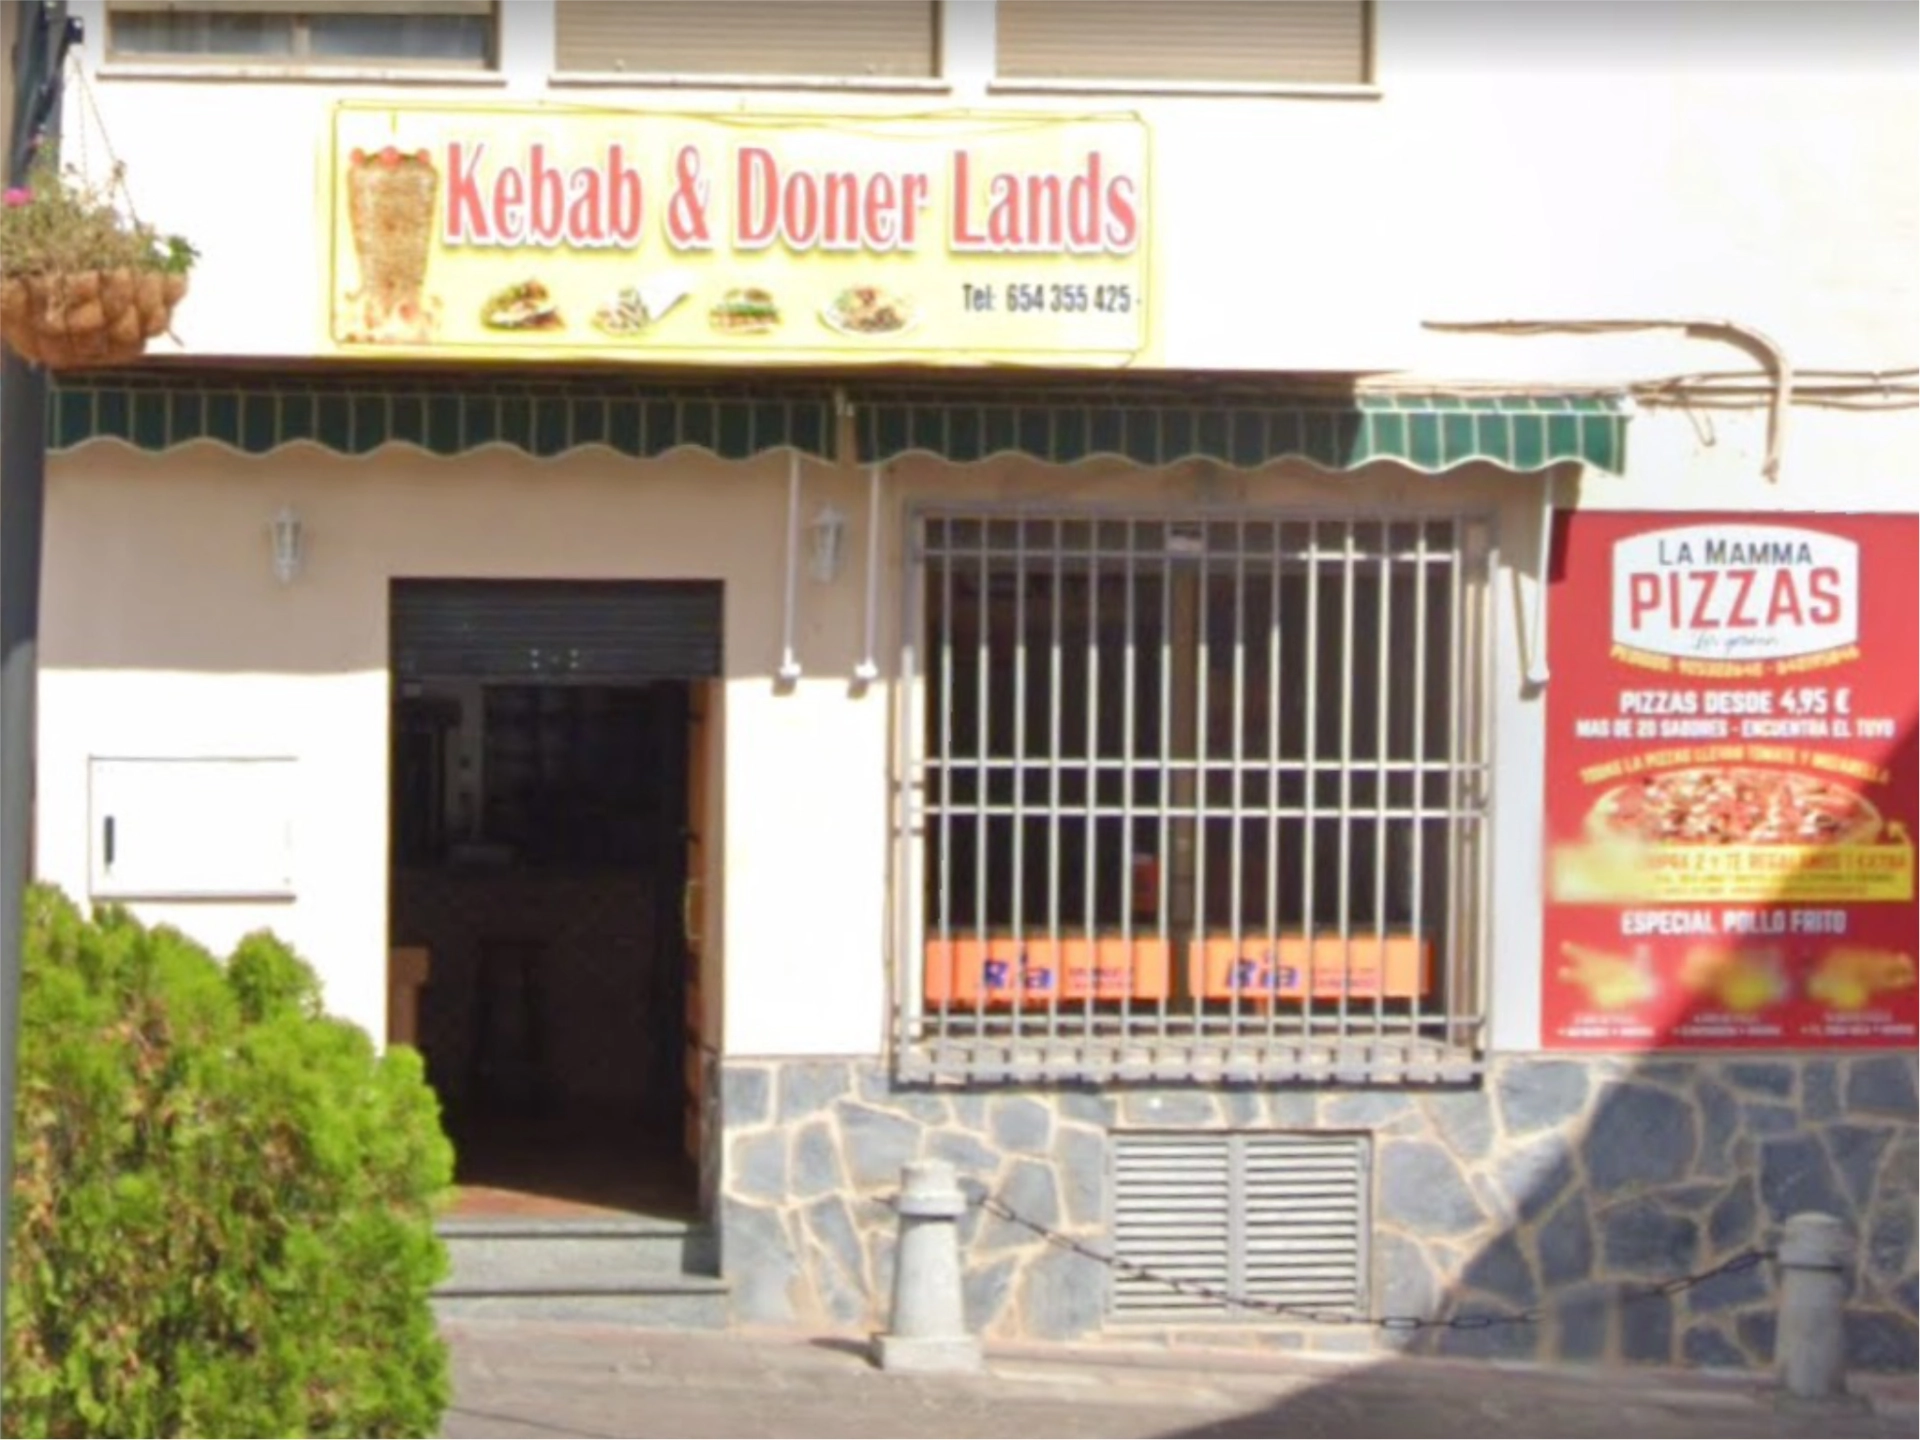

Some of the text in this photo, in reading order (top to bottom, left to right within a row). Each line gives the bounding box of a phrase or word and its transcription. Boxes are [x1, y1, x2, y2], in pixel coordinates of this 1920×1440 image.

[446, 141, 1137, 246] Kebab & Doner Lands
[1006, 283, 1044, 313] 654
[1050, 283, 1089, 313] 355
[1094, 284, 1132, 314] 425
[1658, 539, 1813, 566] LA MAMMA
[1629, 567, 1842, 631] PIZZAS
[1619, 689, 1698, 714] PIZZAS
[1703, 689, 1773, 714] DESDE
[1779, 687, 1828, 716] 4,95
[1620, 910, 1847, 935] ESPECIAL POLLO FRITO
